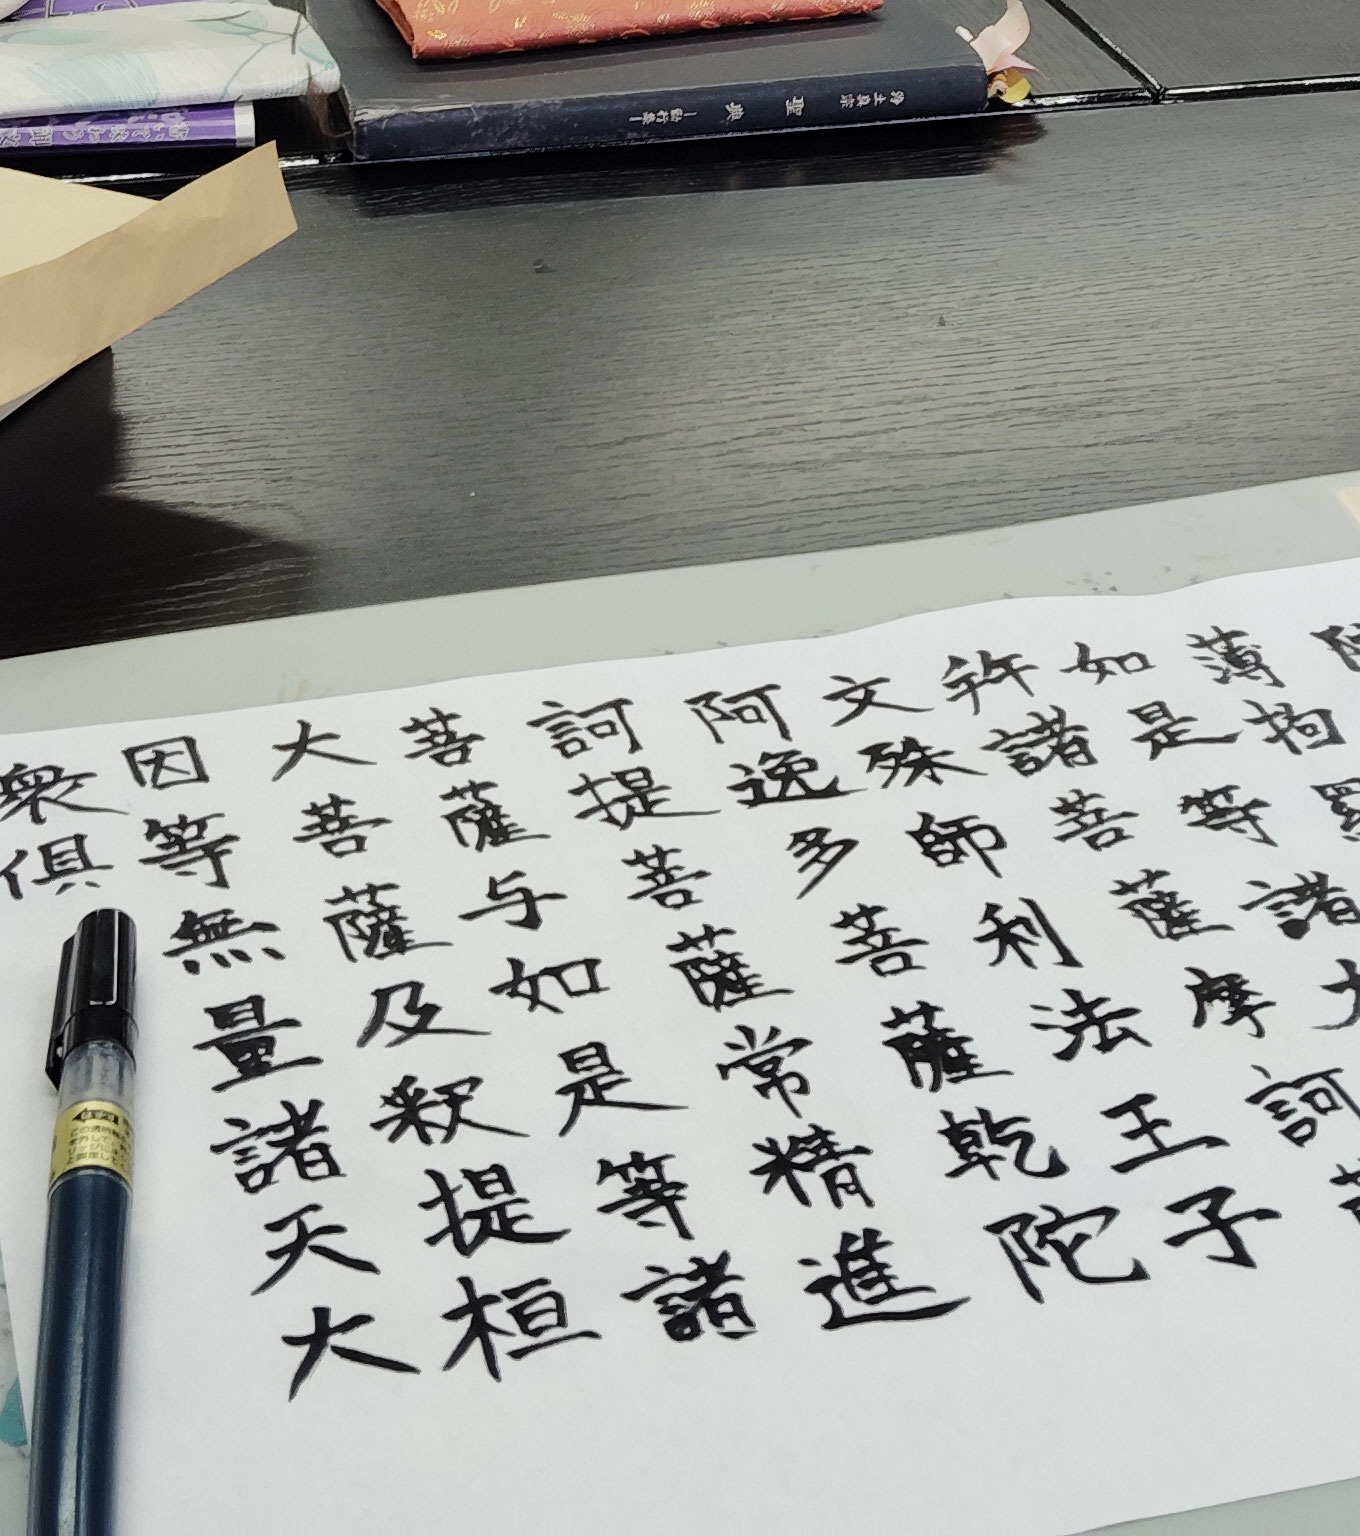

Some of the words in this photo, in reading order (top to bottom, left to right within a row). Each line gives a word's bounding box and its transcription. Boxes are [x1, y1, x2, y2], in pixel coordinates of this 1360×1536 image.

[822, 675, 1282, 1269] 文殊師利法王子
